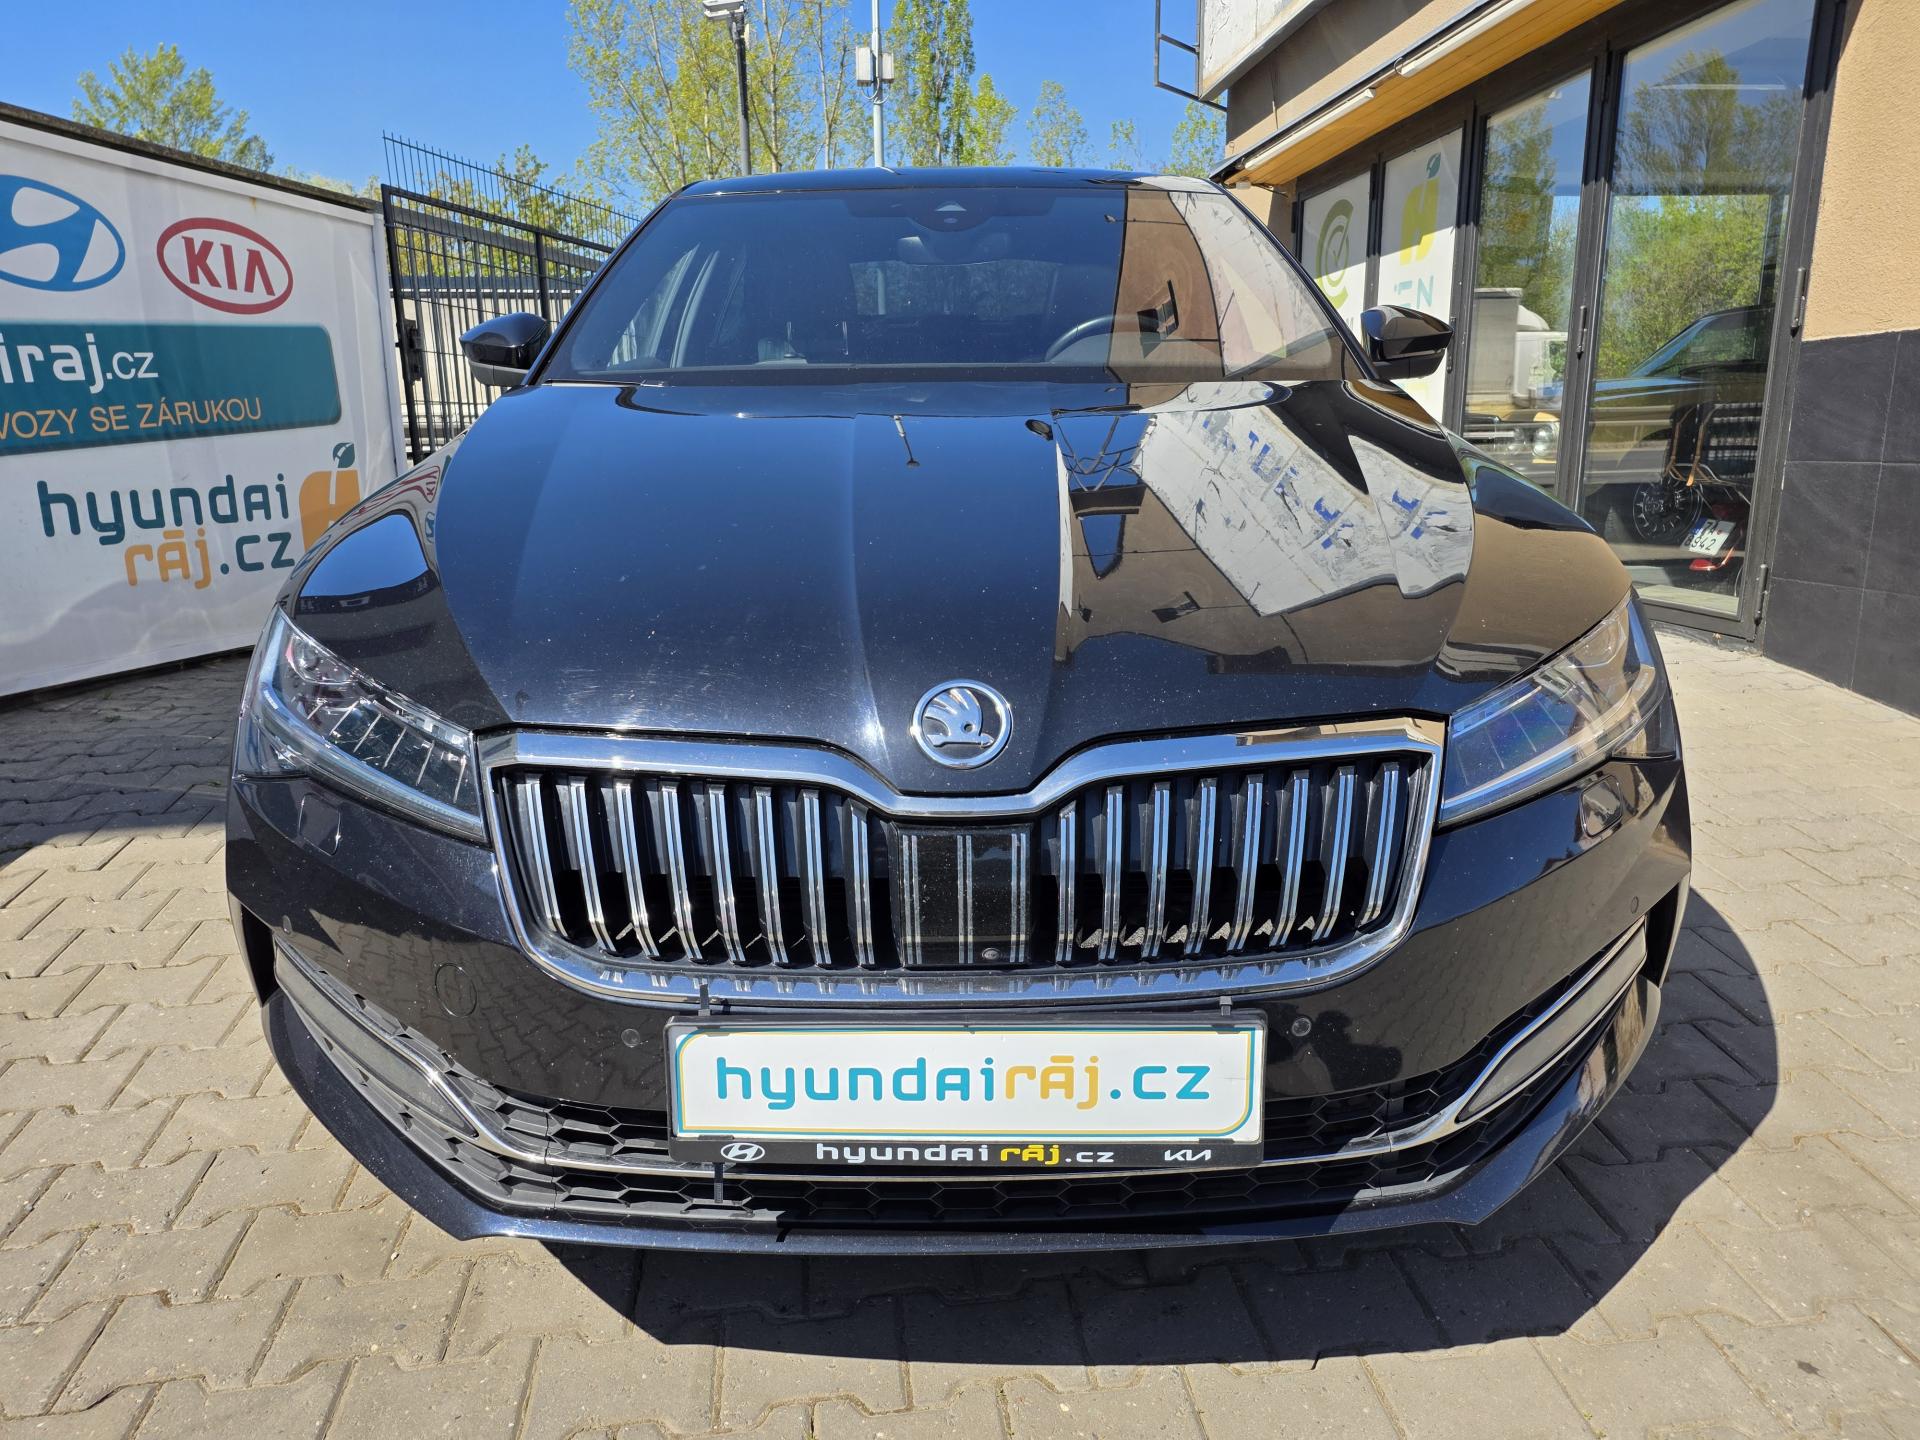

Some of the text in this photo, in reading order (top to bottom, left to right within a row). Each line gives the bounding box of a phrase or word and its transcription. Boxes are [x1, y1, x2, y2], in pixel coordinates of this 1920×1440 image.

[181, 235, 276, 296] KIA
[90, 405, 130, 432] SE
[136, 397, 262, 428] ZÁRUKOU
[36, 473, 289, 546] hyundai
[816, 1143, 989, 1164] hyundai
